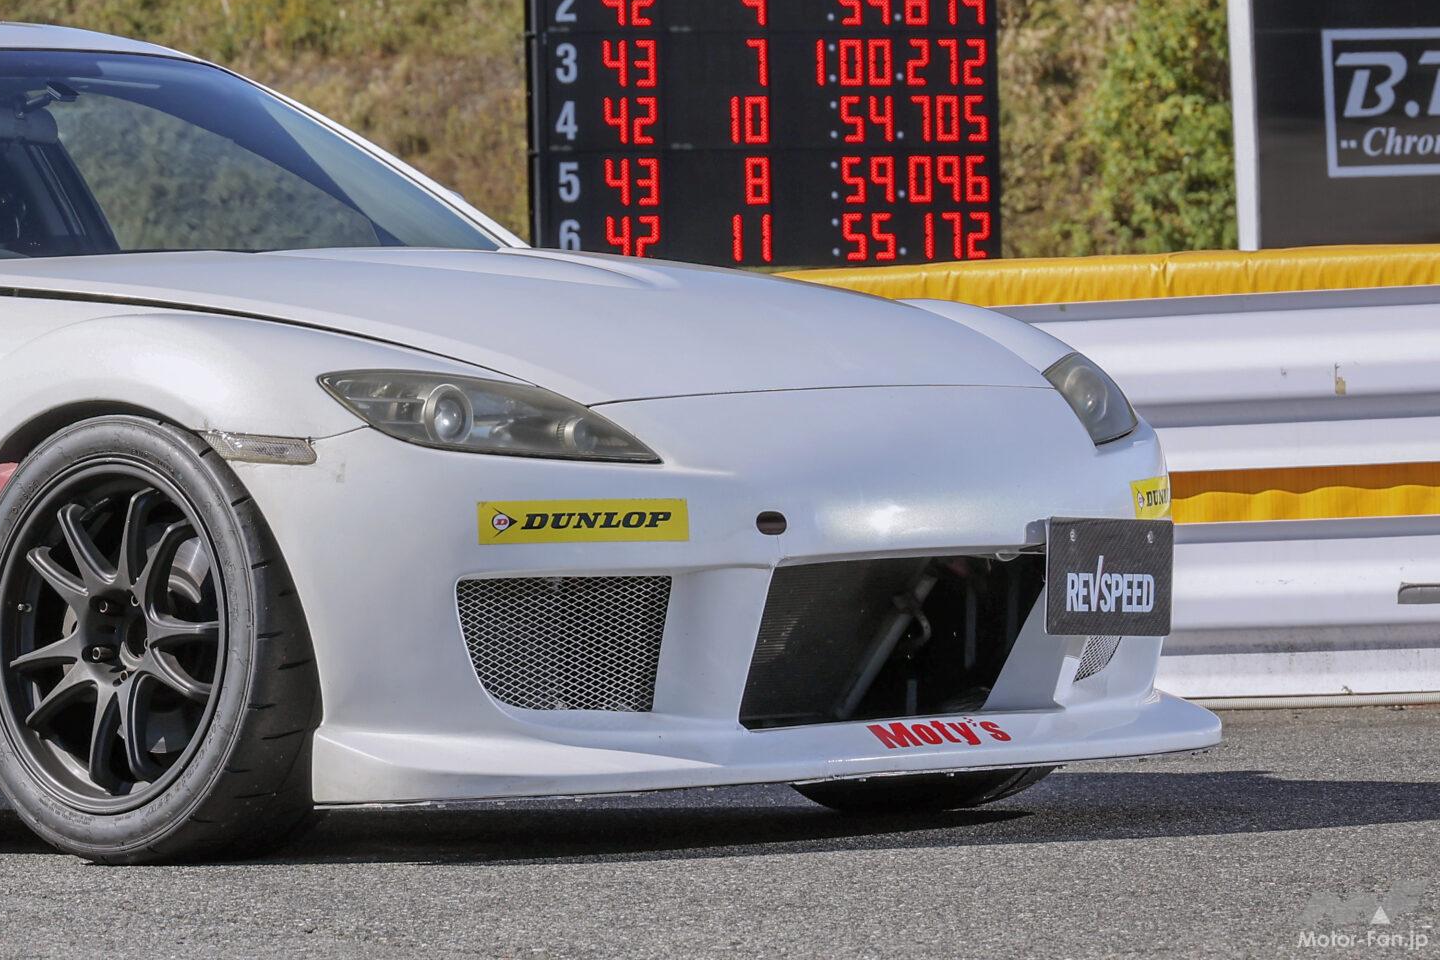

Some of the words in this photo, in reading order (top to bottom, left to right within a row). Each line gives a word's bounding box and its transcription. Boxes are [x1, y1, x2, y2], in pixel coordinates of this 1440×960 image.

[555, 43, 578, 84] 3
[602, 39, 657, 88] 43
[746, 38, 768, 87] 7
[816, 38, 987, 87] 1:00.272
[1335, 51, 1440, 118] B.
[555, 100, 578, 140] 4
[603, 96, 658, 145] 42
[730, 95, 769, 144] 10
[559, 162, 580, 203] 5
[604, 157, 660, 207] 43
[744, 156, 771, 205] 8
[559, 219, 581, 251] 6
[605, 215, 661, 258] 42
[732, 213, 772, 262] 11
[521, 511, 672, 530] DUNLOP
[1146, 488, 1169, 507] DUN
[1066, 555, 1155, 613] REVSPEED
[866, 717, 1012, 749] Moty's
